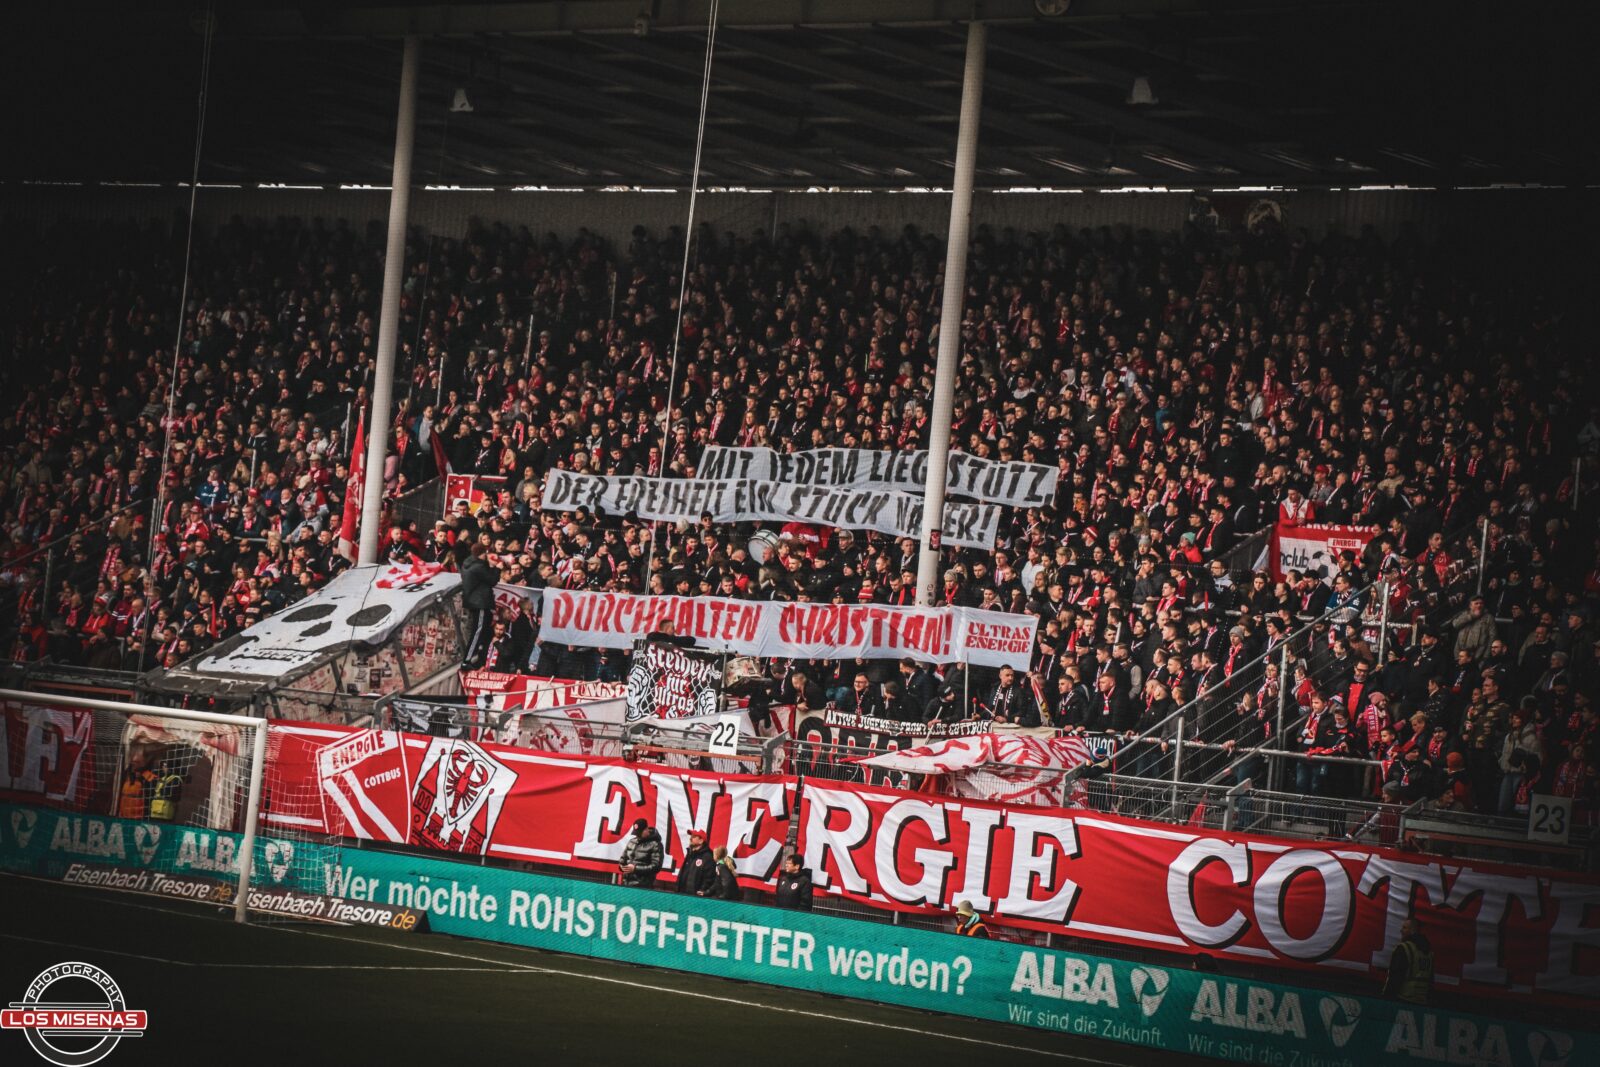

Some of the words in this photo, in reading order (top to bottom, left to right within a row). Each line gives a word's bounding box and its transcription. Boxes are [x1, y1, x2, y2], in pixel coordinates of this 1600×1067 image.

[699, 448, 754, 480] MIT
[869, 449, 1054, 504] LIEGSTÜTZ,
[550, 473, 608, 508] DER
[614, 478, 728, 516] FREIHEIT
[734, 479, 780, 515] EIN
[896, 495, 993, 543] NÄER!
[552, 592, 763, 642] DURCHHALTEN
[779, 603, 953, 656] CHRISTIAN!
[965, 635, 1030, 653] ENERGIE
[968, 621, 1031, 641] ULTRAS
[666, 672, 688, 694] für
[333, 729, 386, 770] ENERGIE
[712, 721, 736, 748] 22
[363, 767, 402, 789] COTTBUS
[49, 815, 128, 860] ALBA
[1533, 803, 1566, 835] 23
[573, 763, 1083, 925] ENERGIE
[64, 863, 154, 890] Eisenbach
[324, 863, 380, 902] Wer
[387, 876, 498, 922] möchte
[507, 889, 816, 972] ROHSTOFF-RETTER
[827, 943, 973, 996] werden?
[326, 898, 417, 930] Tresore.de
[1010, 951, 1119, 1009] ALBA
[1008, 1003, 1032, 1024] Wir
[1036, 1008, 1070, 1031] sind
[1074, 1016, 1097, 1036] die
[1102, 1019, 1167, 1048] Zukunft.
[1190, 979, 1307, 1039] ALBA
[1385, 1010, 1513, 1067] ALBA
